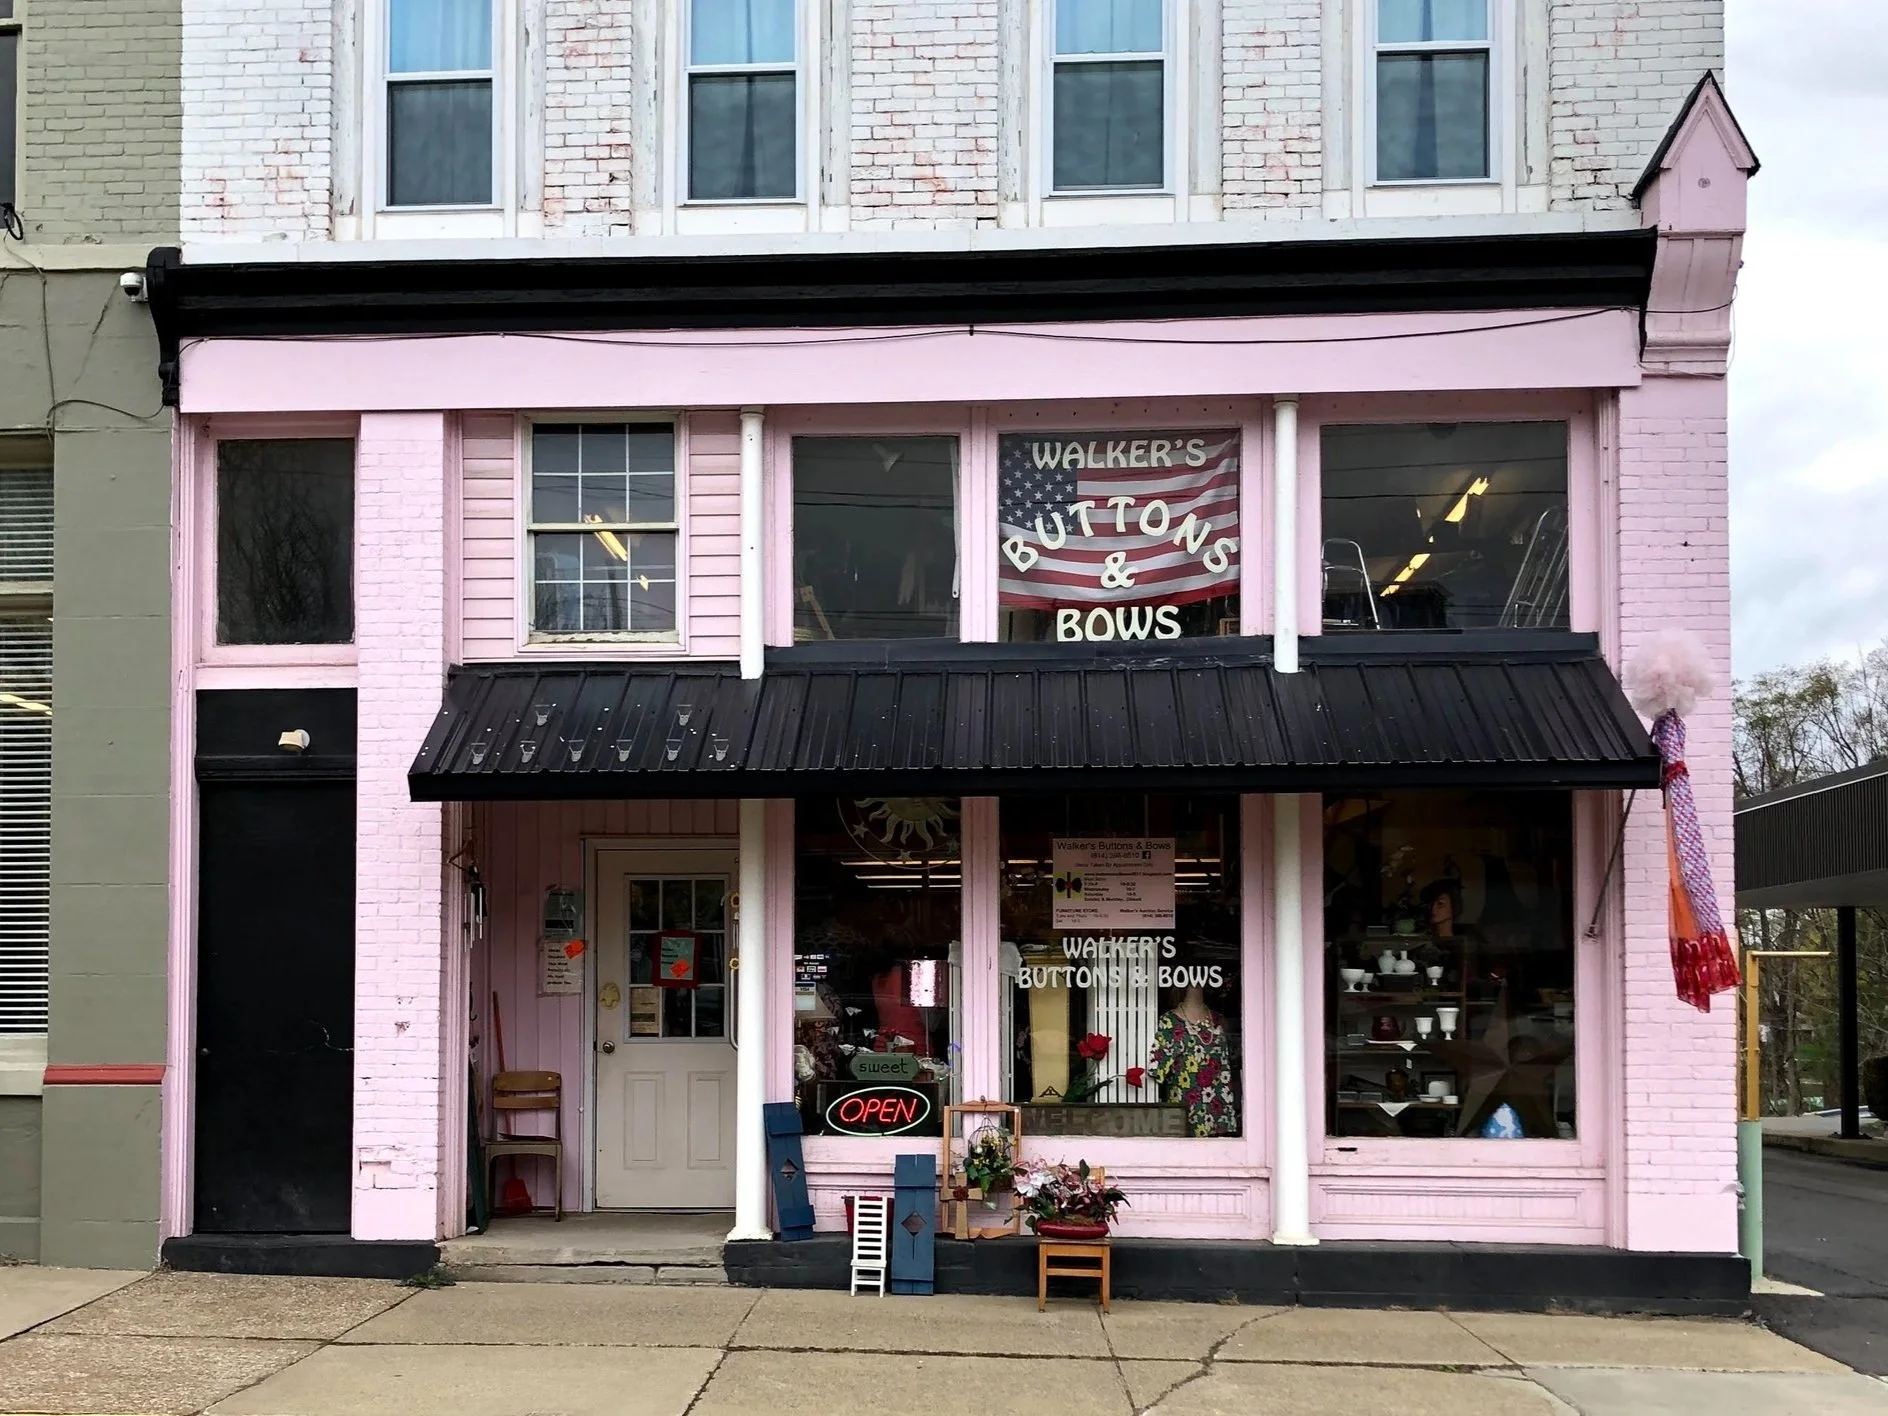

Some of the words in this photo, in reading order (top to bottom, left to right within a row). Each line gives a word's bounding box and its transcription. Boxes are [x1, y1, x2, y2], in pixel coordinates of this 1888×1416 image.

[1032, 438, 1208, 470] WALKER'S
[1001, 496, 1238, 574] BUTTONS
[1100, 551, 1136, 589] &
[1056, 605, 1182, 642] BOWS
[1056, 841, 1096, 850] Walker's
[1098, 841, 1134, 850] Buttons
[1135, 841, 1143, 850] &
[1145, 841, 1172, 850] Bows
[1062, 936, 1177, 960] WALKER'S
[1018, 966, 1121, 989] BUTTONS
[1131, 966, 1150, 988] &
[1158, 965, 1224, 989] BOWS
[859, 1058, 909, 1074] sweet
[840, 1098, 918, 1123] OPEN
